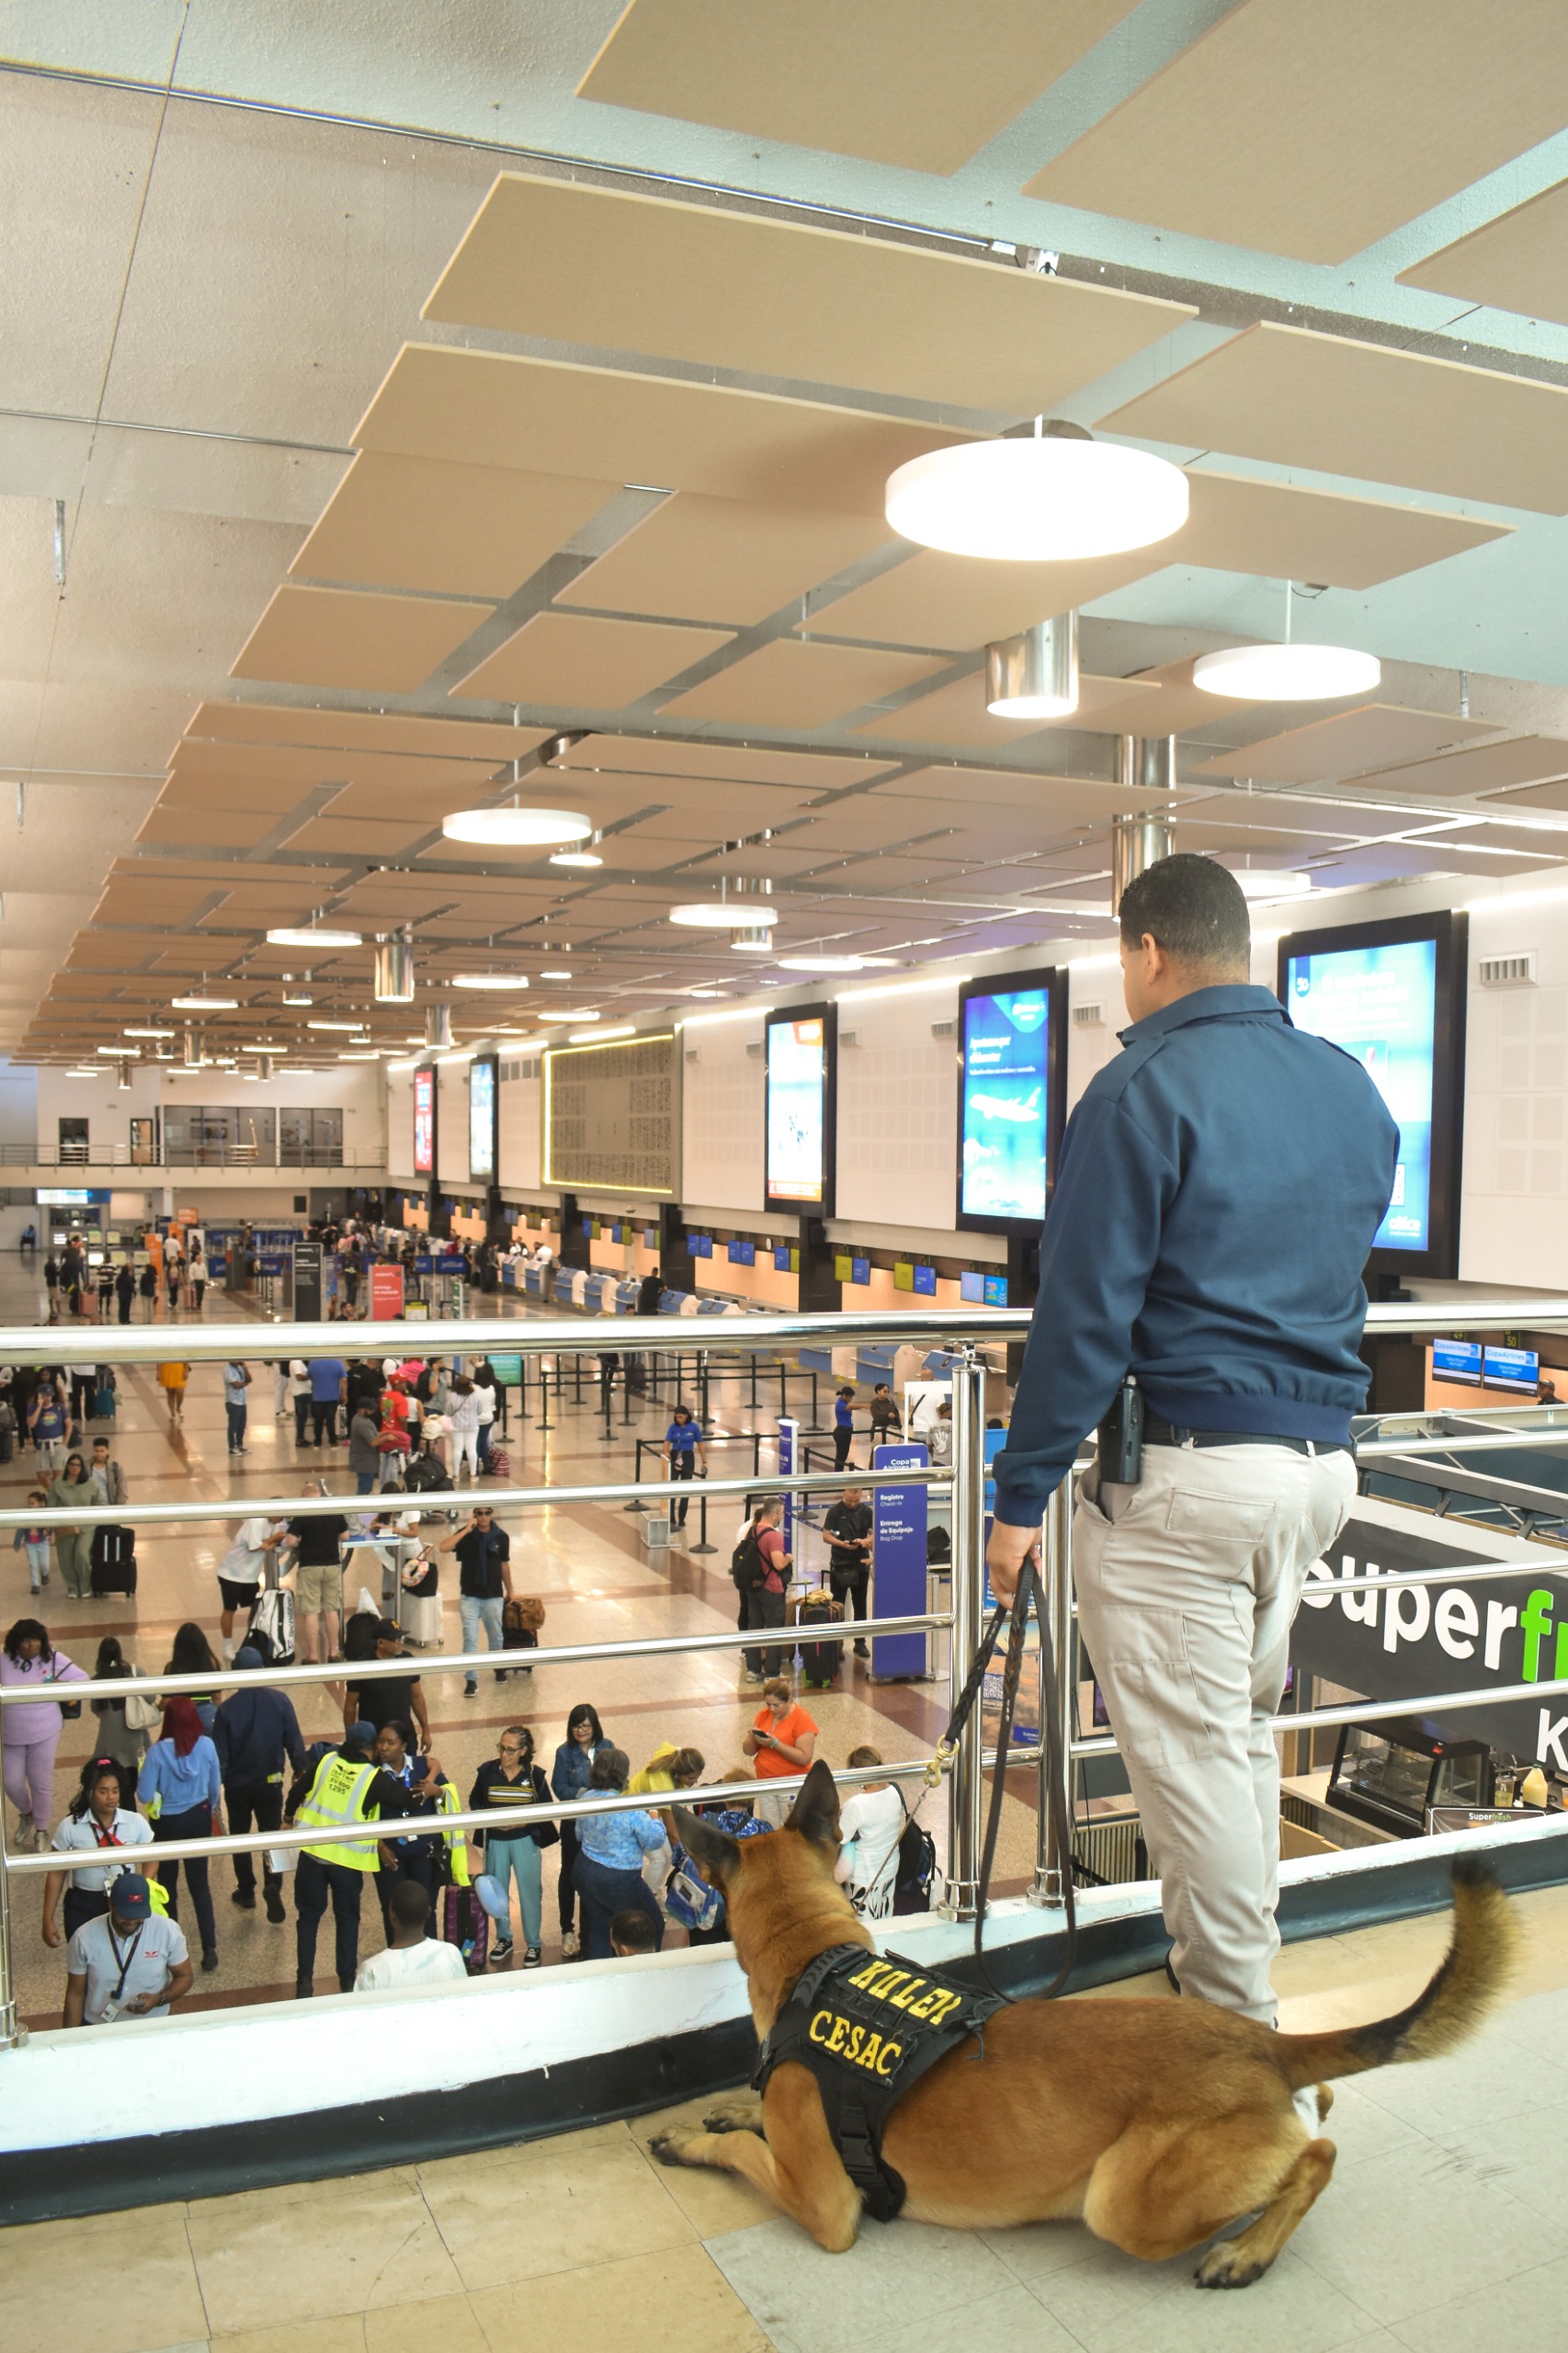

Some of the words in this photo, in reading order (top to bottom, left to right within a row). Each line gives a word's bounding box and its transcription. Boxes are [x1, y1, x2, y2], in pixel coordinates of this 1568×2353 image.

[1296, 977, 1309, 992] 5G
[1389, 1215, 1421, 1231] altice
[1506, 1336, 1517, 1347] 50
[1486, 1348, 1526, 1360] CopaAirlines
[329, 1783, 347, 1795] 1295
[1469, 1812, 1512, 1822] Superfresh
[809, 2010, 902, 2075] CESAC
